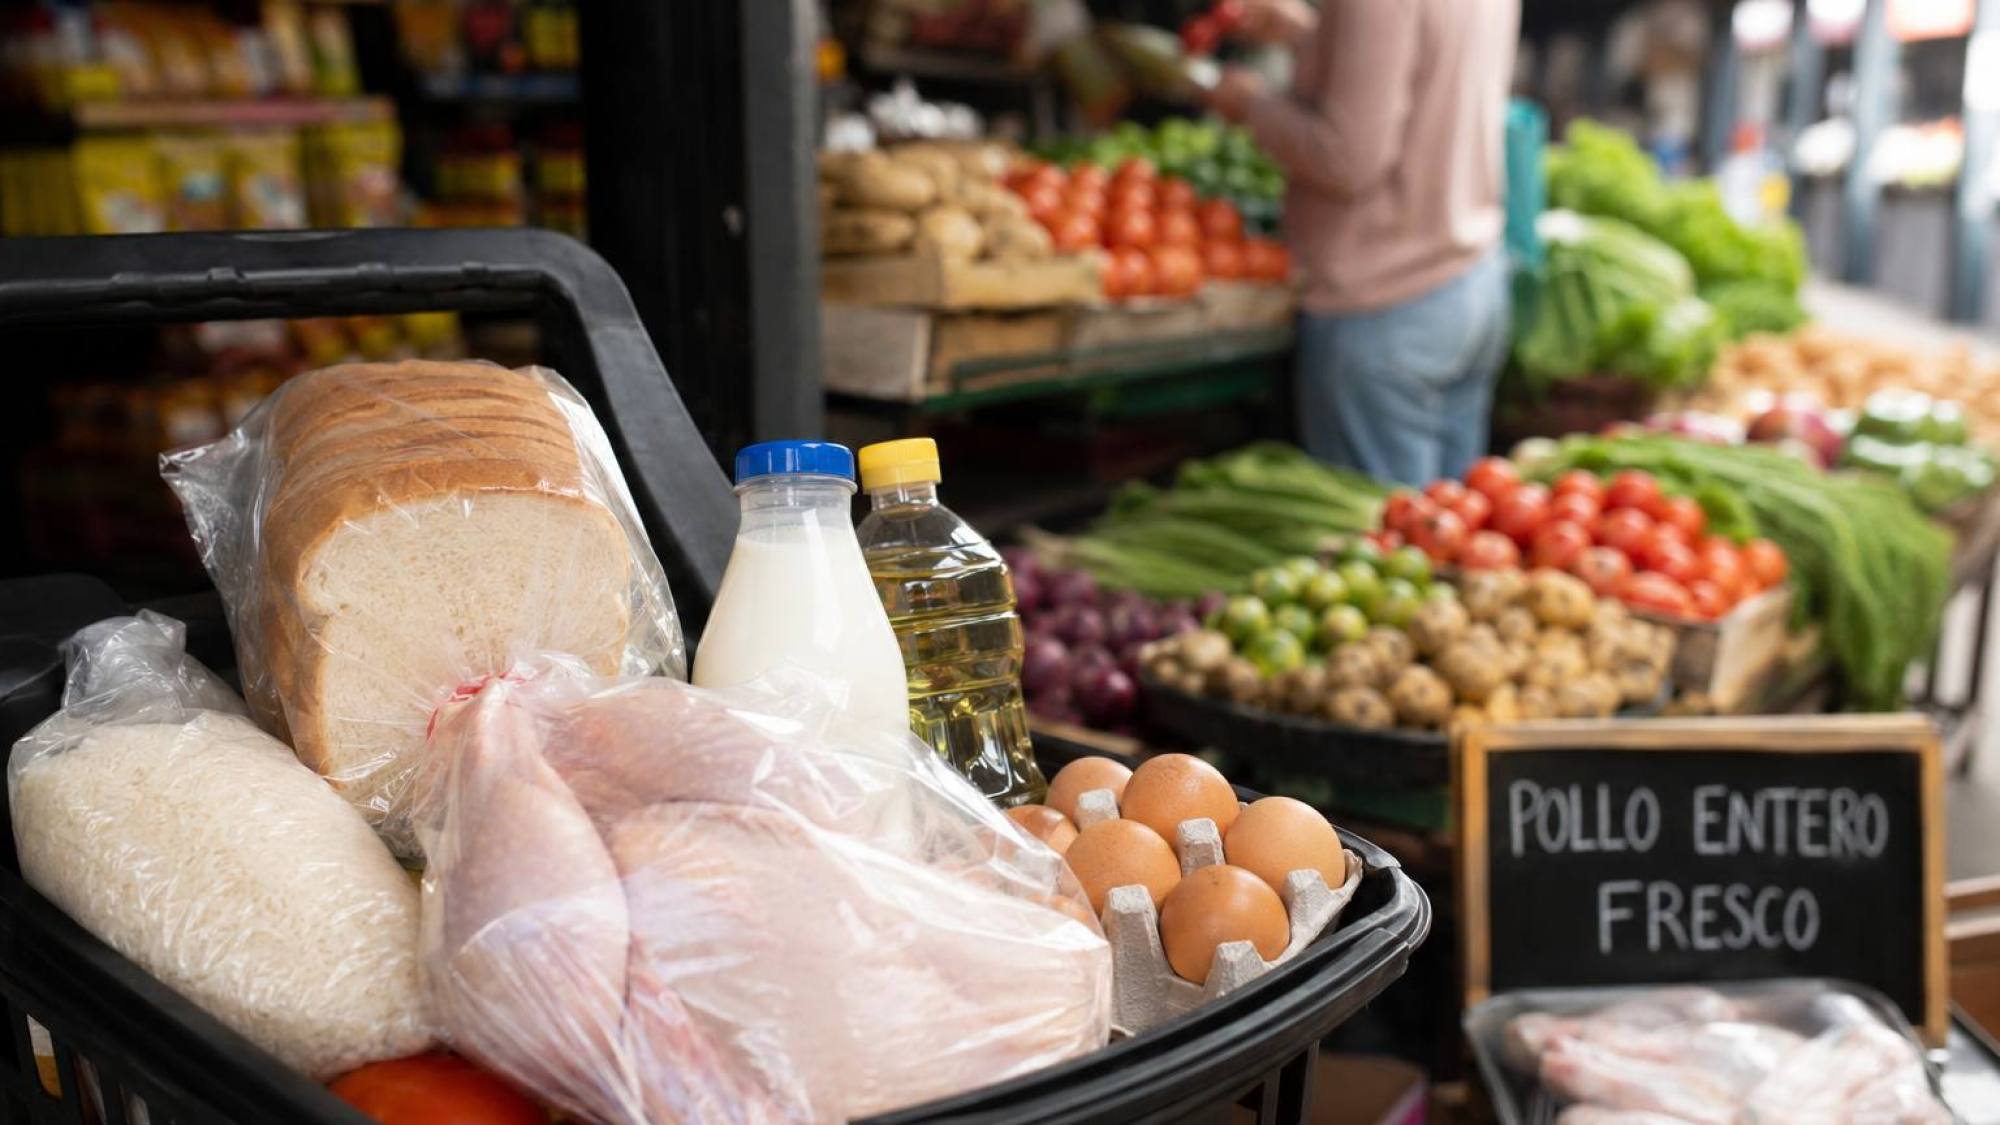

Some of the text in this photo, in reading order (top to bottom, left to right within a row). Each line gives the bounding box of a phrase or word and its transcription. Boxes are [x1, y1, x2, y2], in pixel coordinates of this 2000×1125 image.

[1509, 780, 1888, 857] POLLO ENTERO
[1599, 880, 1819, 953] FRESCO
